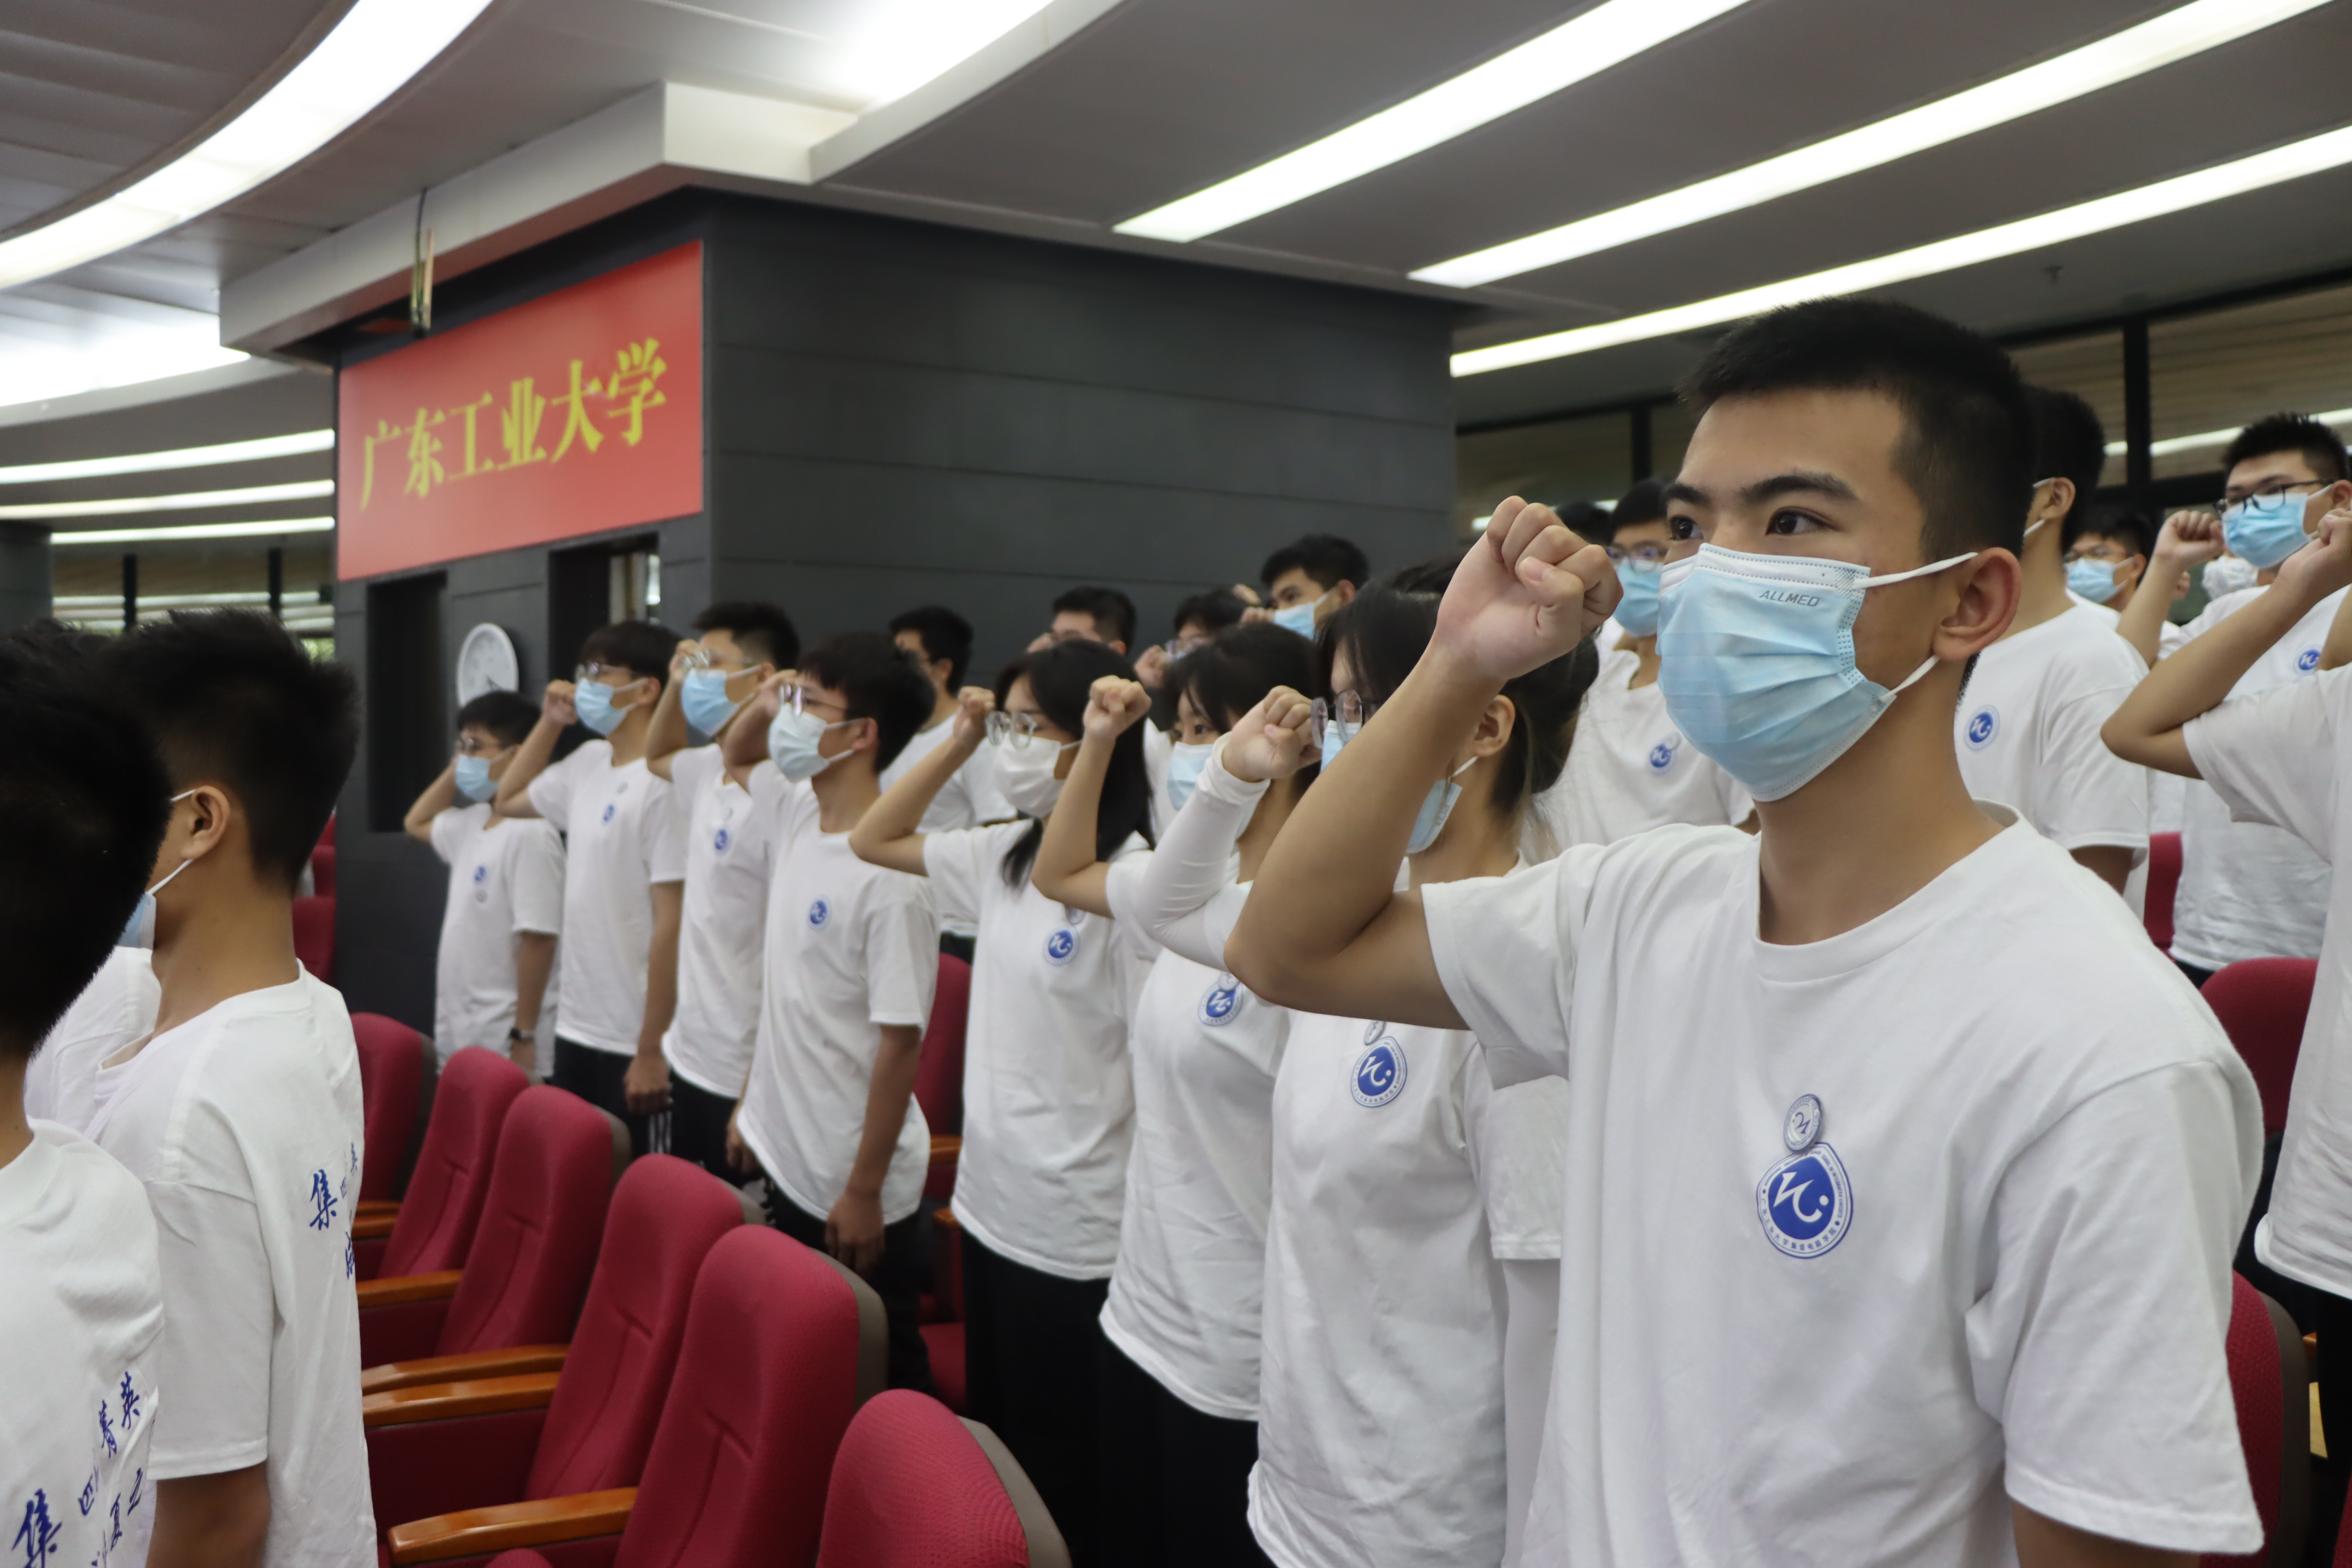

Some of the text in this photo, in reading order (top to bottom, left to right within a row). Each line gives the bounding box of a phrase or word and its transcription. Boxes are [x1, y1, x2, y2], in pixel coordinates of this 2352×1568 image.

[361, 338, 667, 512] 广东工业大学
[1759, 590, 1820, 607] ALLMED
